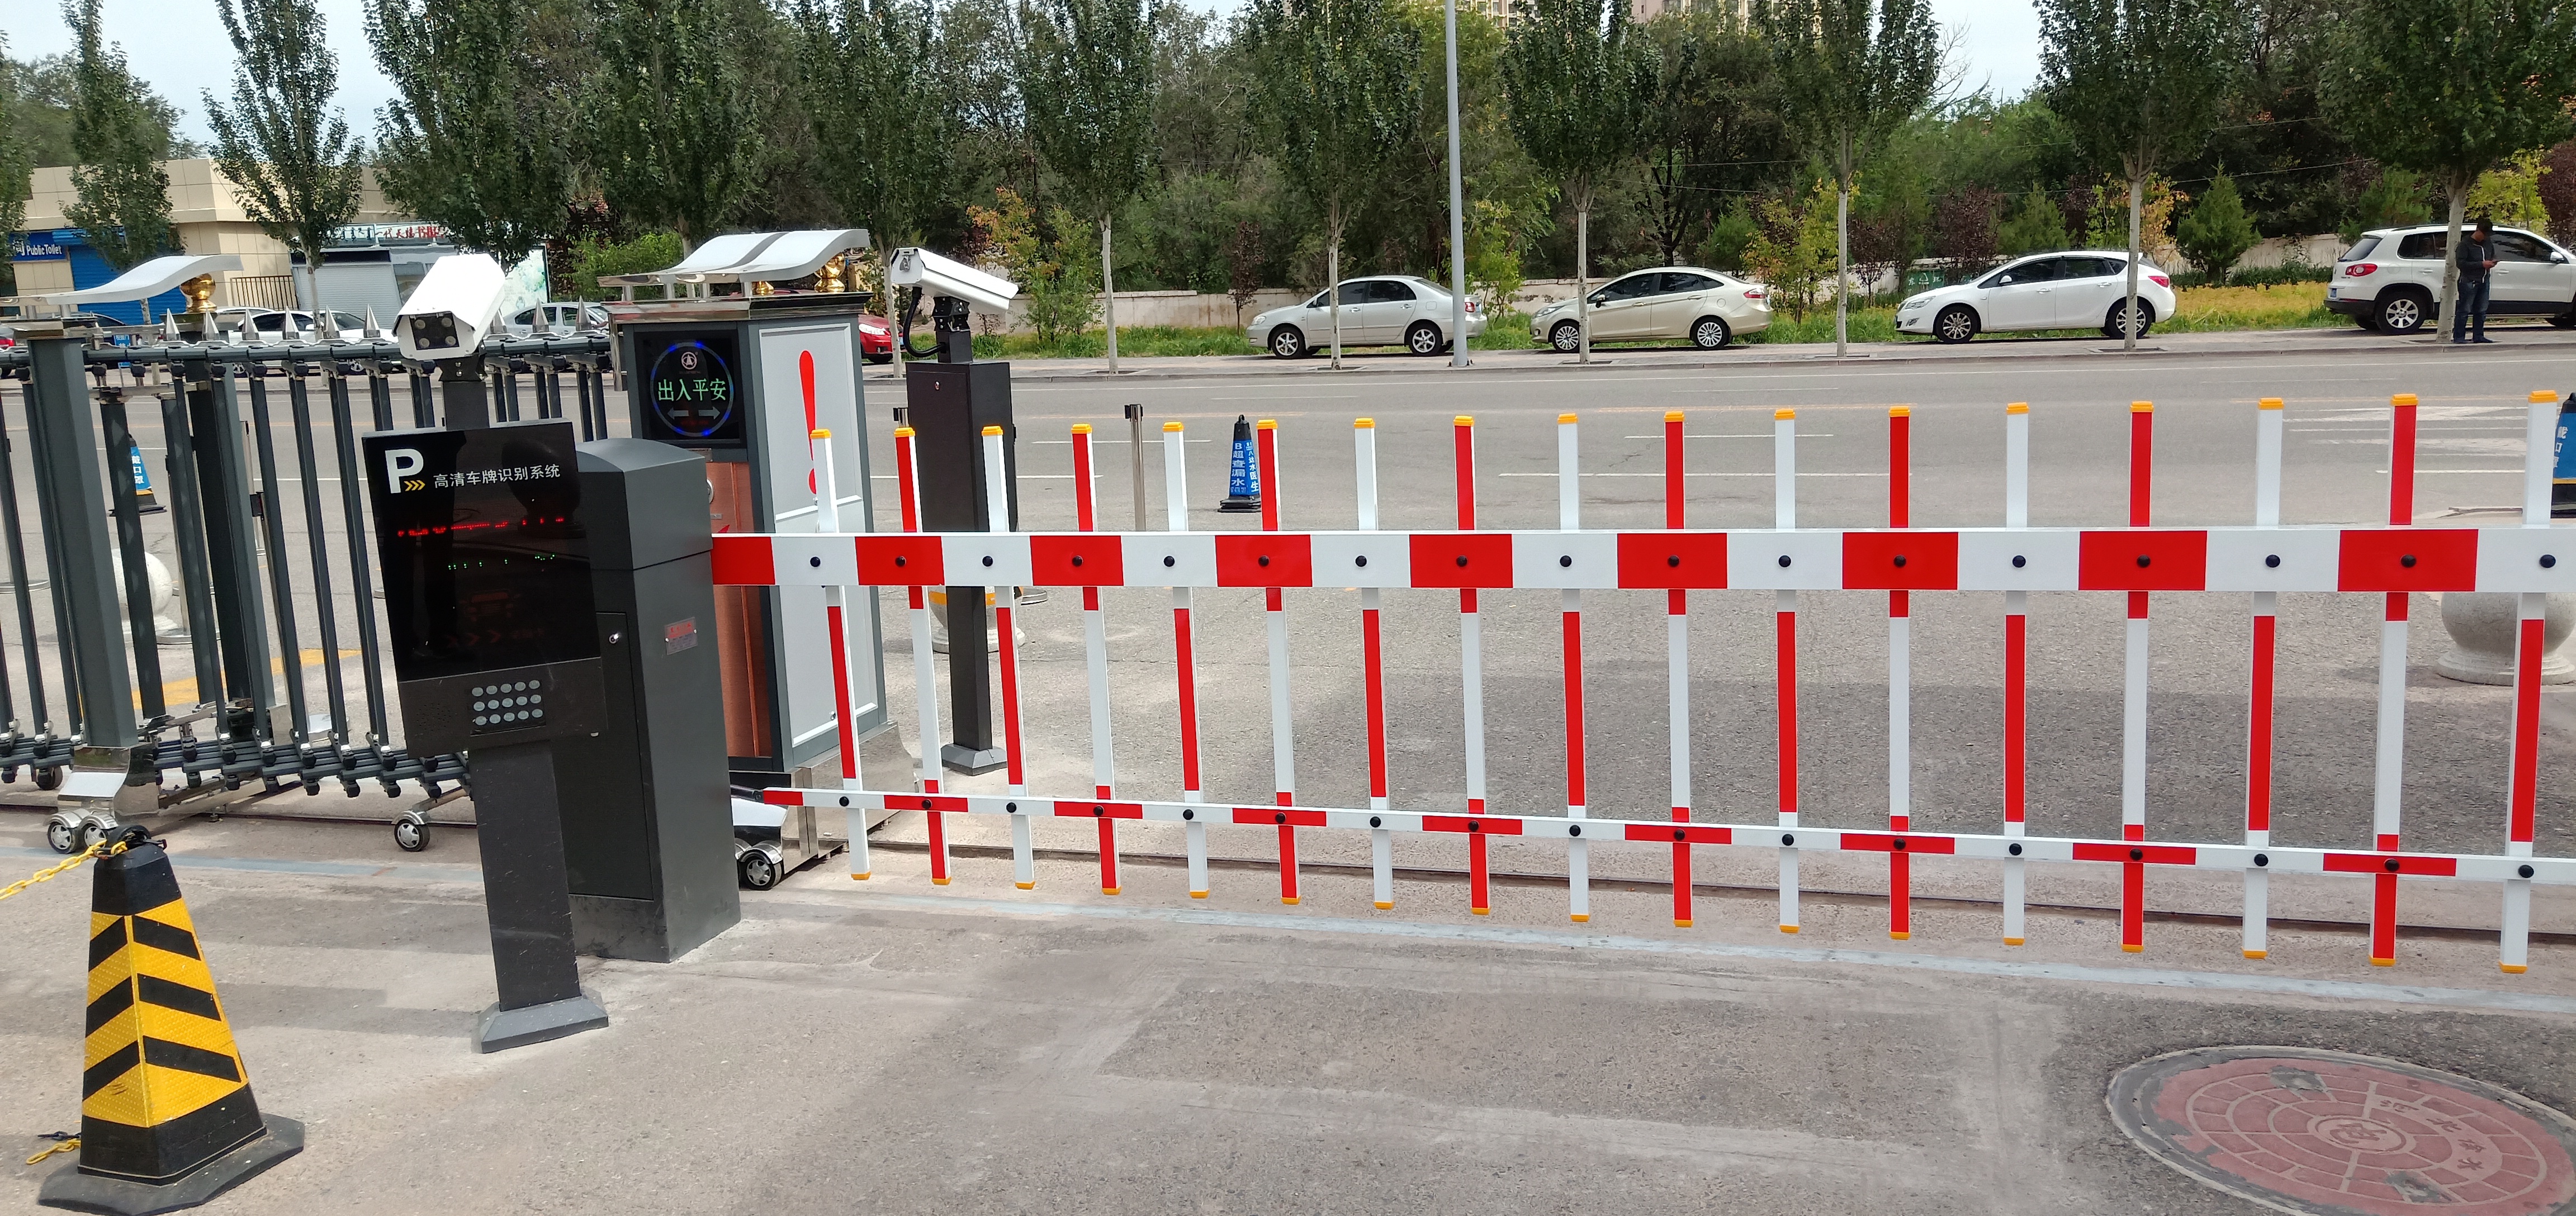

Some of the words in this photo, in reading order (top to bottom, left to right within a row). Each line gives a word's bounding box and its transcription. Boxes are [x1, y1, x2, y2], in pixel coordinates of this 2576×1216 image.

[26, 245, 45, 255] Public
[44, 244, 62, 255] Toilet
[658, 378, 726, 401] 出入平安
[385, 448, 424, 493] P
[433, 464, 560, 488] 高清车牌识别系统
[1232, 443, 1246, 486] B超查漏水
